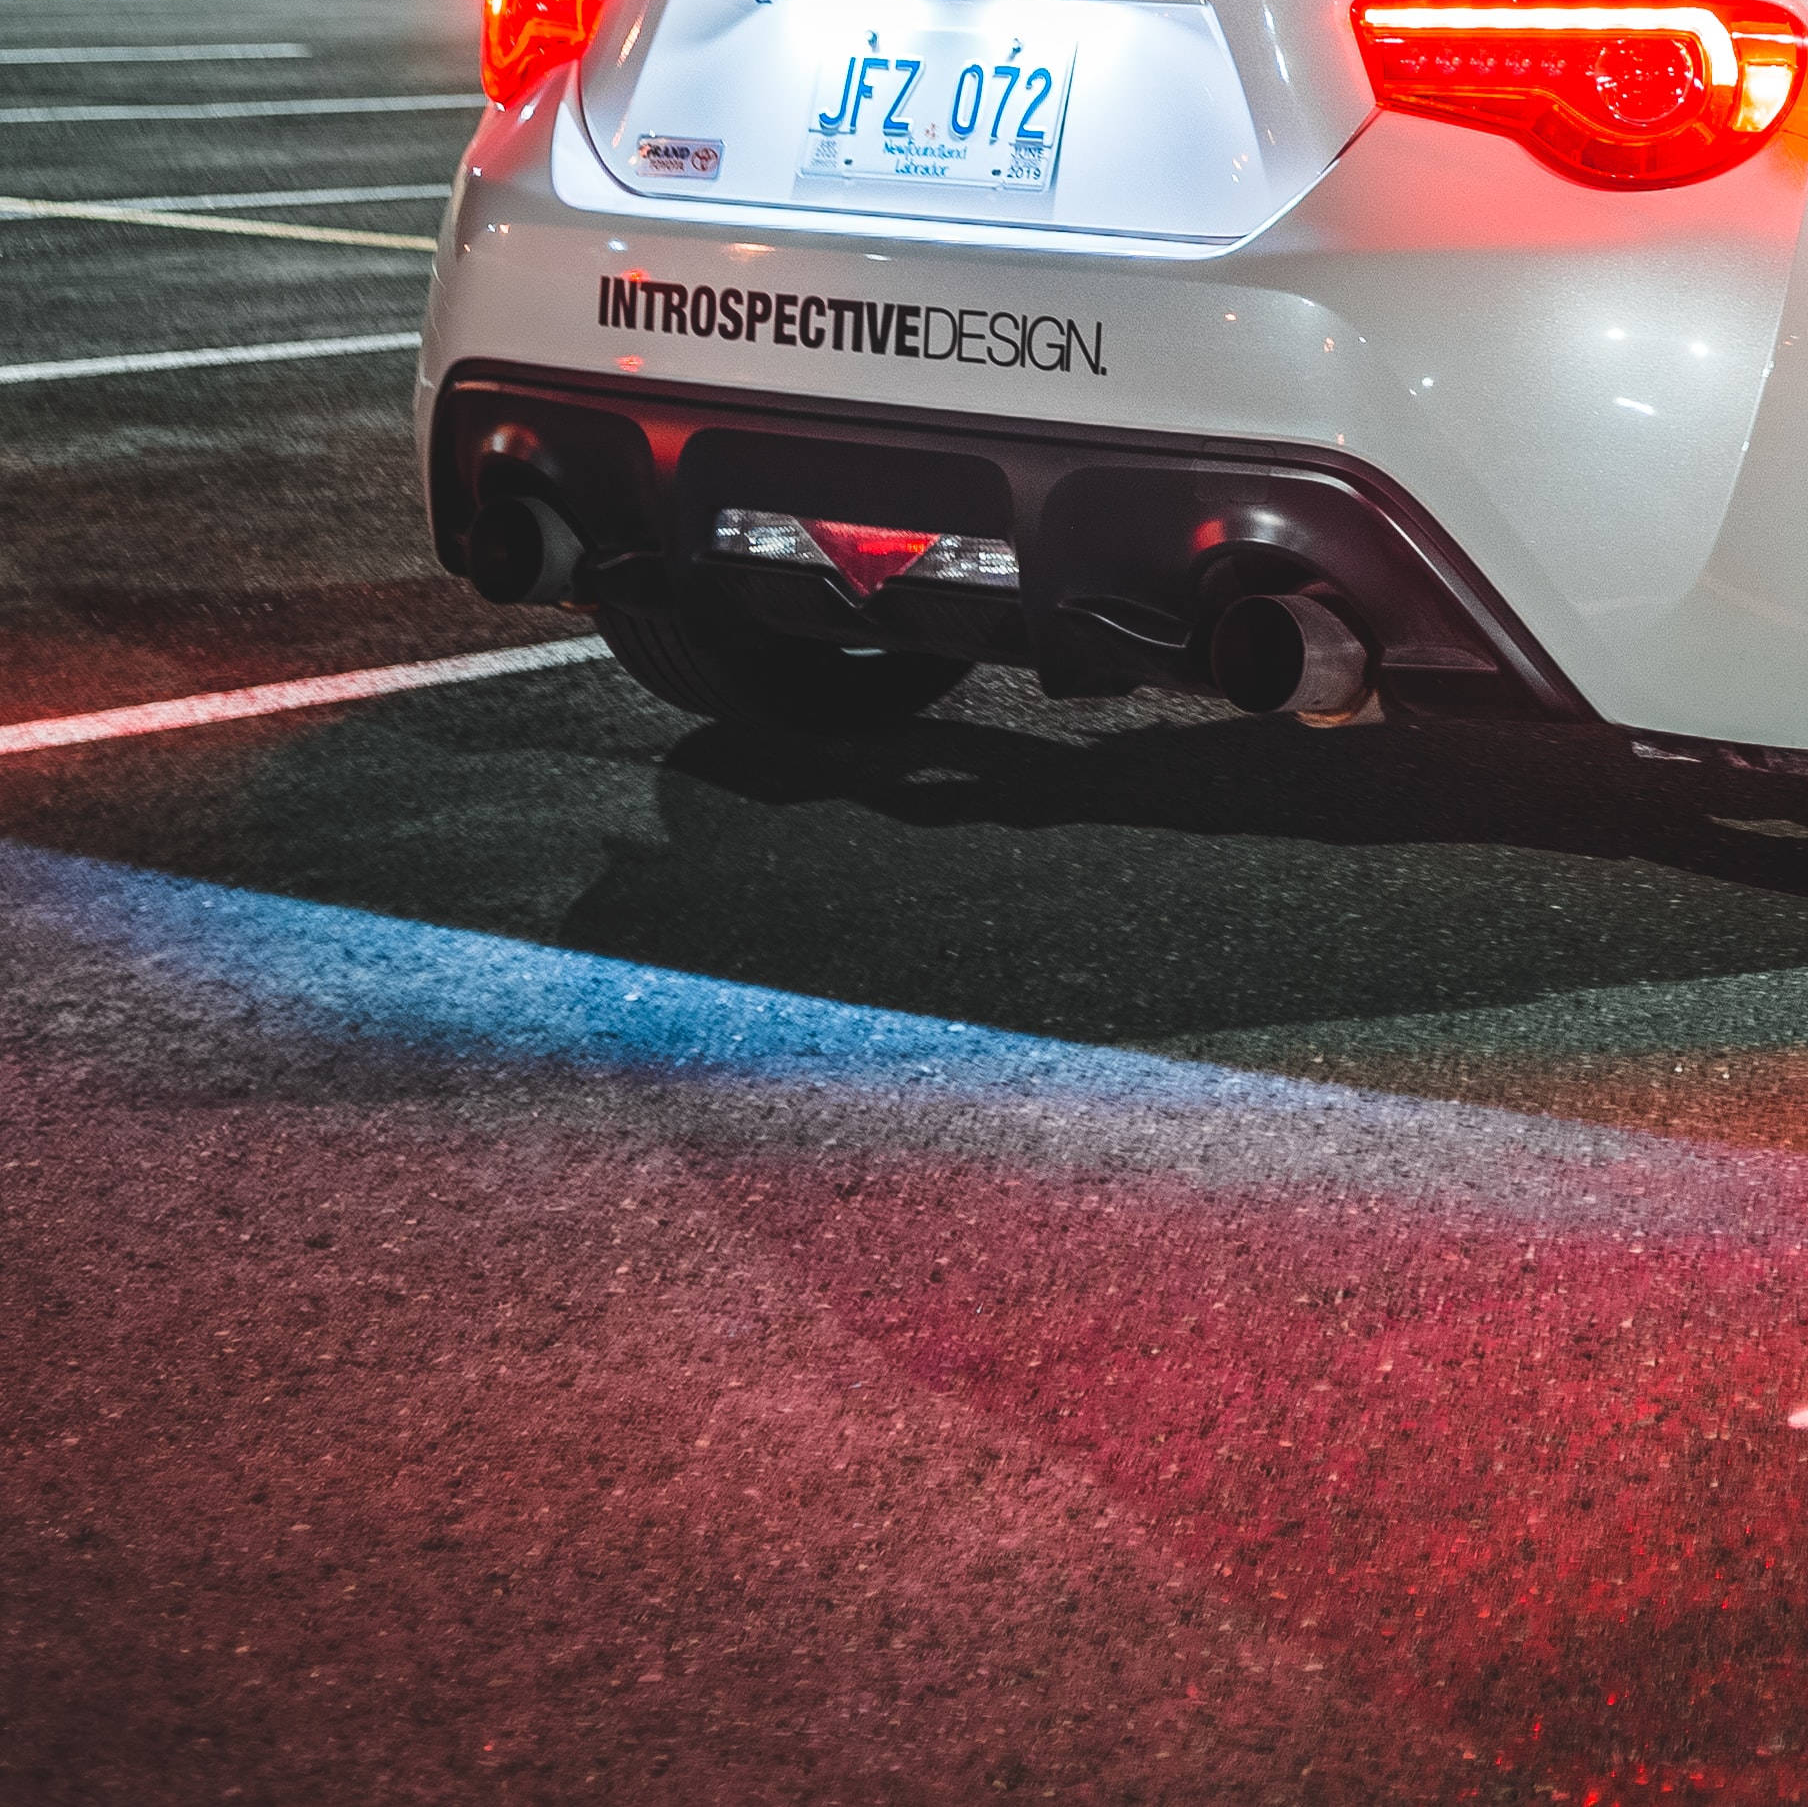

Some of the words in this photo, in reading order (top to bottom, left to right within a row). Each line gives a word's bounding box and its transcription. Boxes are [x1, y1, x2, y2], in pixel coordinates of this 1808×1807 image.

[818, 57, 921, 136] JFZ
[951, 64, 1053, 140] 072
[1009, 143, 1045, 160] JUNE
[1006, 164, 1041, 180] 2019
